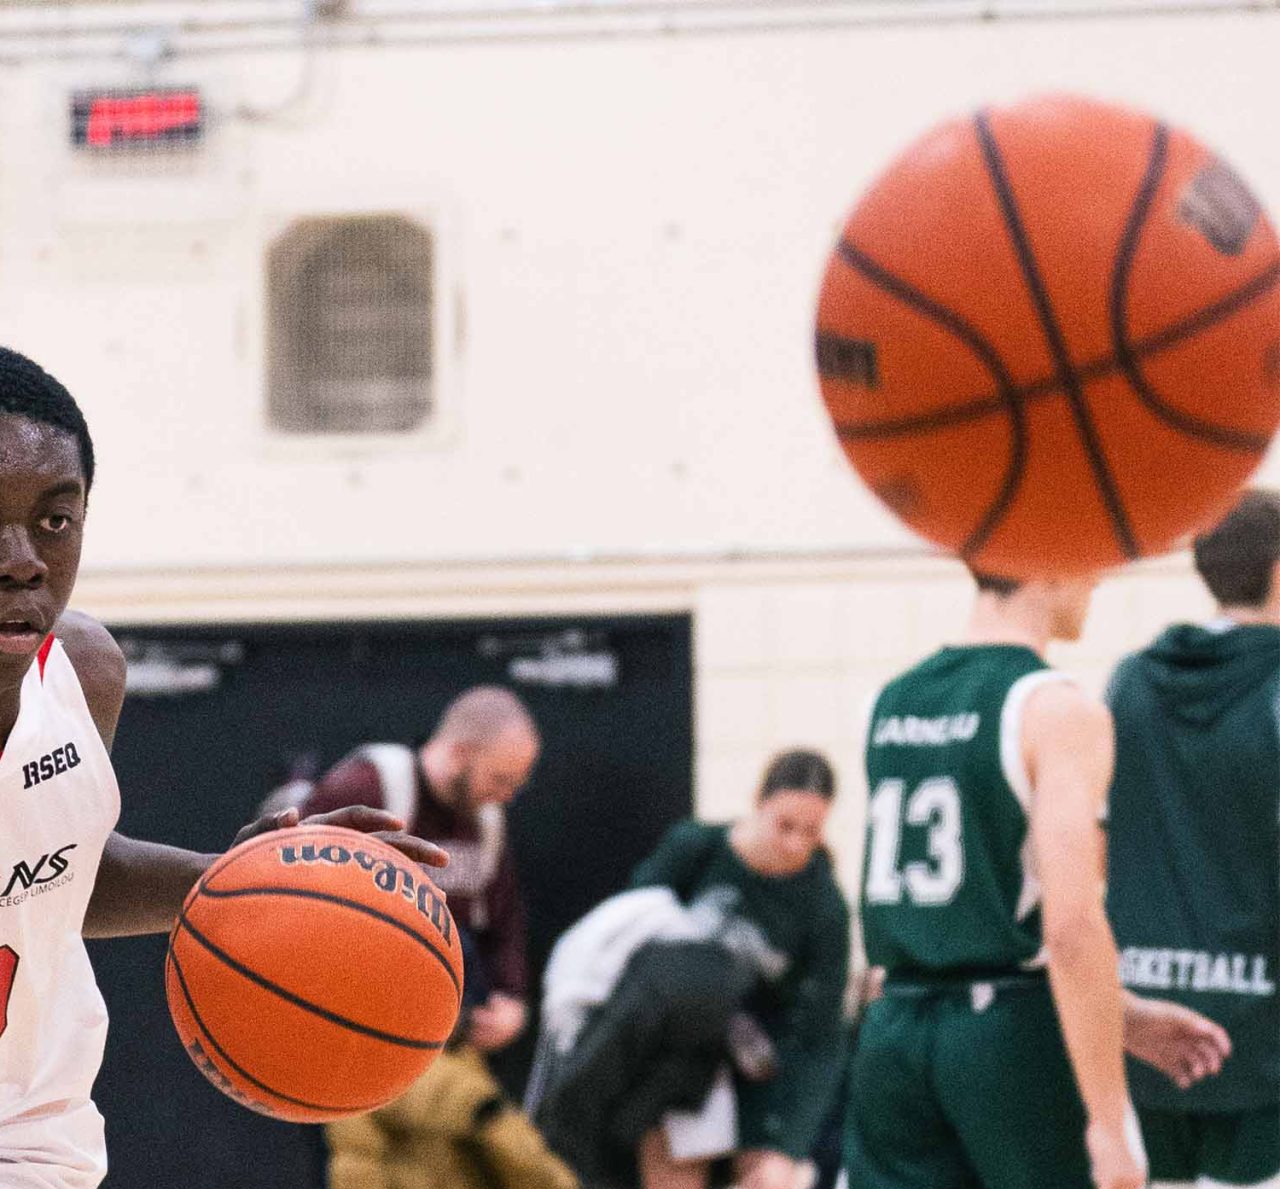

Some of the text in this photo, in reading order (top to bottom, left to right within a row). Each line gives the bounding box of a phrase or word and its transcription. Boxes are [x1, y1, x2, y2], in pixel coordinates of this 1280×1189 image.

[22, 742, 81, 790] RSEQ
[866, 776, 965, 907] 13
[277, 844, 454, 947] Wilson
